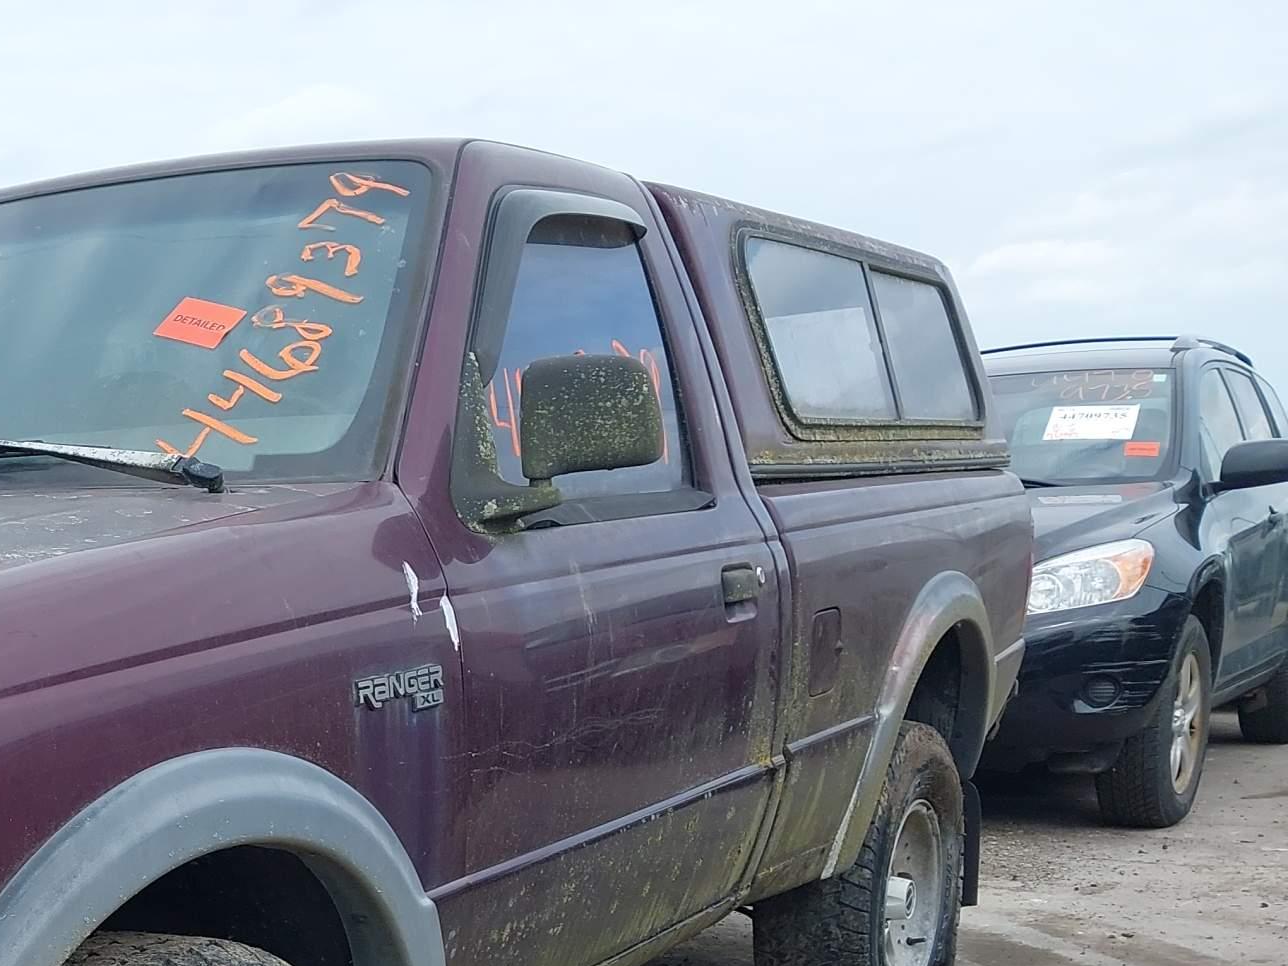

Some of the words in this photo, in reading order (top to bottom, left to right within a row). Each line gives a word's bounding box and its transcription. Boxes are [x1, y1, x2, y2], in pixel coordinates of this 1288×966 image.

[155, 172, 410, 459] 44689379
[174, 314, 226, 331] DETAILED
[355, 665, 444, 709] RANGER
